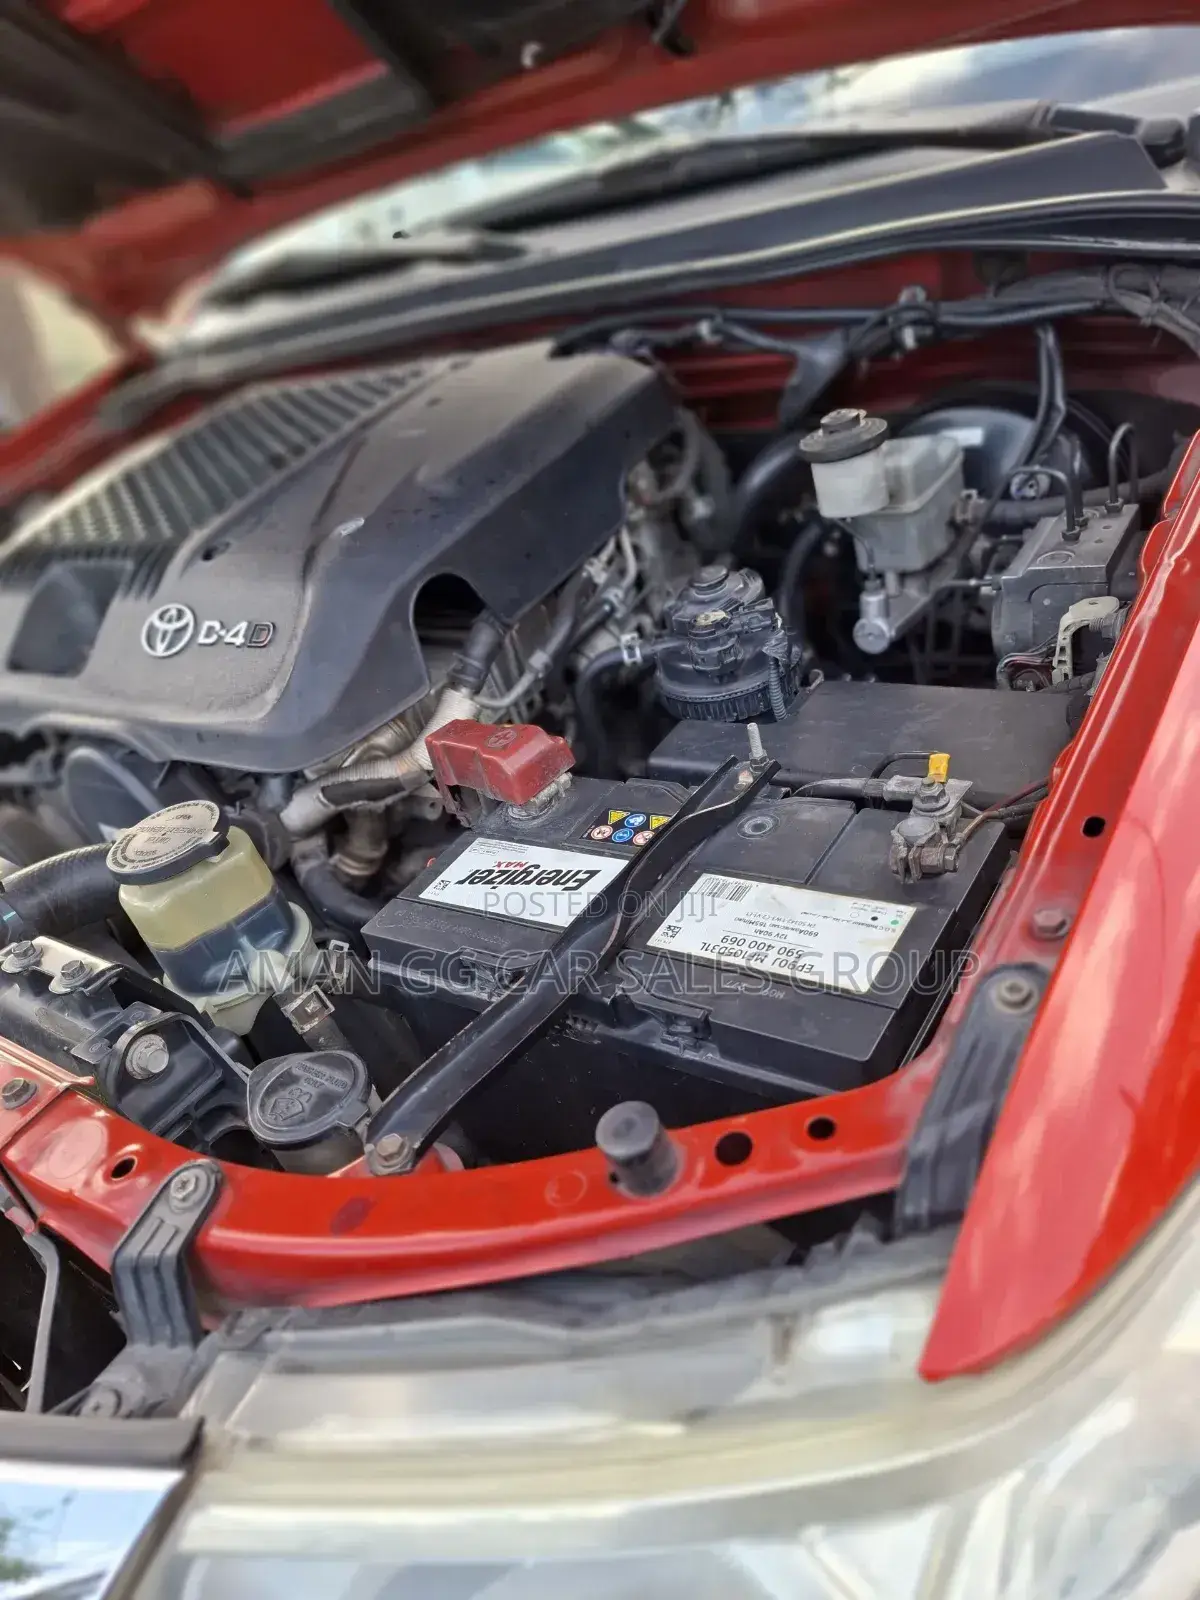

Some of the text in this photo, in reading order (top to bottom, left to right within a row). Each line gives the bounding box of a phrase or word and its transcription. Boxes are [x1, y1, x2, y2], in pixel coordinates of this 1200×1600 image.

[495, 860, 529, 869] MAX
[454, 864, 602, 892] Energizer
[753, 928, 788, 940] 12V 90Ah
[700, 942, 815, 974] EP90J MF105D31L
[720, 935, 806, 960] 590 400 069
